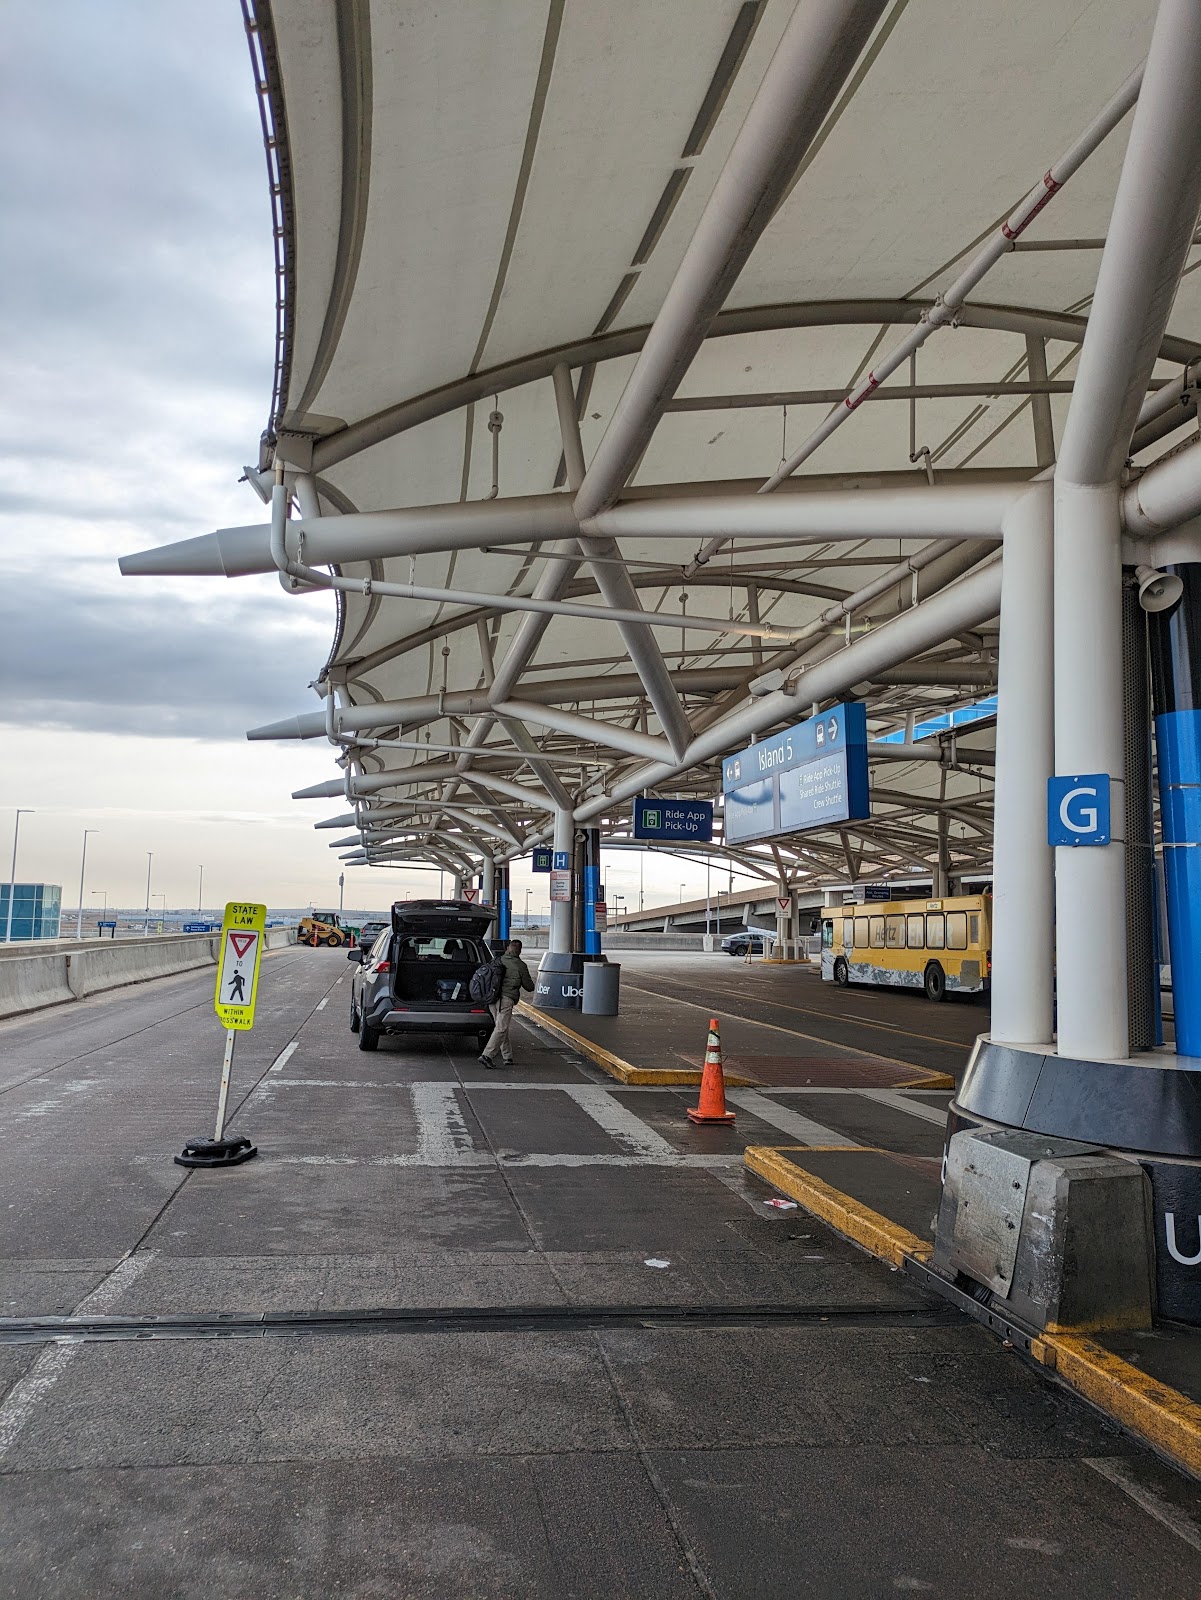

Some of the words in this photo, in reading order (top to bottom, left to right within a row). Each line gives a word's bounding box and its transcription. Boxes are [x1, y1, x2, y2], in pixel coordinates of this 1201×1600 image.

[758, 745, 784, 771] Island
[787, 738, 793, 761] 5
[824, 763, 841, 778] Pick-Up
[799, 786, 814, 799] Shared
[815, 783, 824, 794] Ride
[825, 778, 842, 791] Shuttle
[813, 799, 825, 809] Crew
[826, 792, 842, 806] Shuttle
[665, 810, 685, 819] Ride
[687, 811, 706, 821] App
[1059, 787, 1098, 834] G
[665, 821, 699, 832] Pick-Up
[556, 854, 566, 867] H
[232, 905, 259, 915] STATE
[234, 916, 254, 925] LAW
[875, 924, 897, 941] Hertz
[223, 1008, 244, 1016] WITHIN
